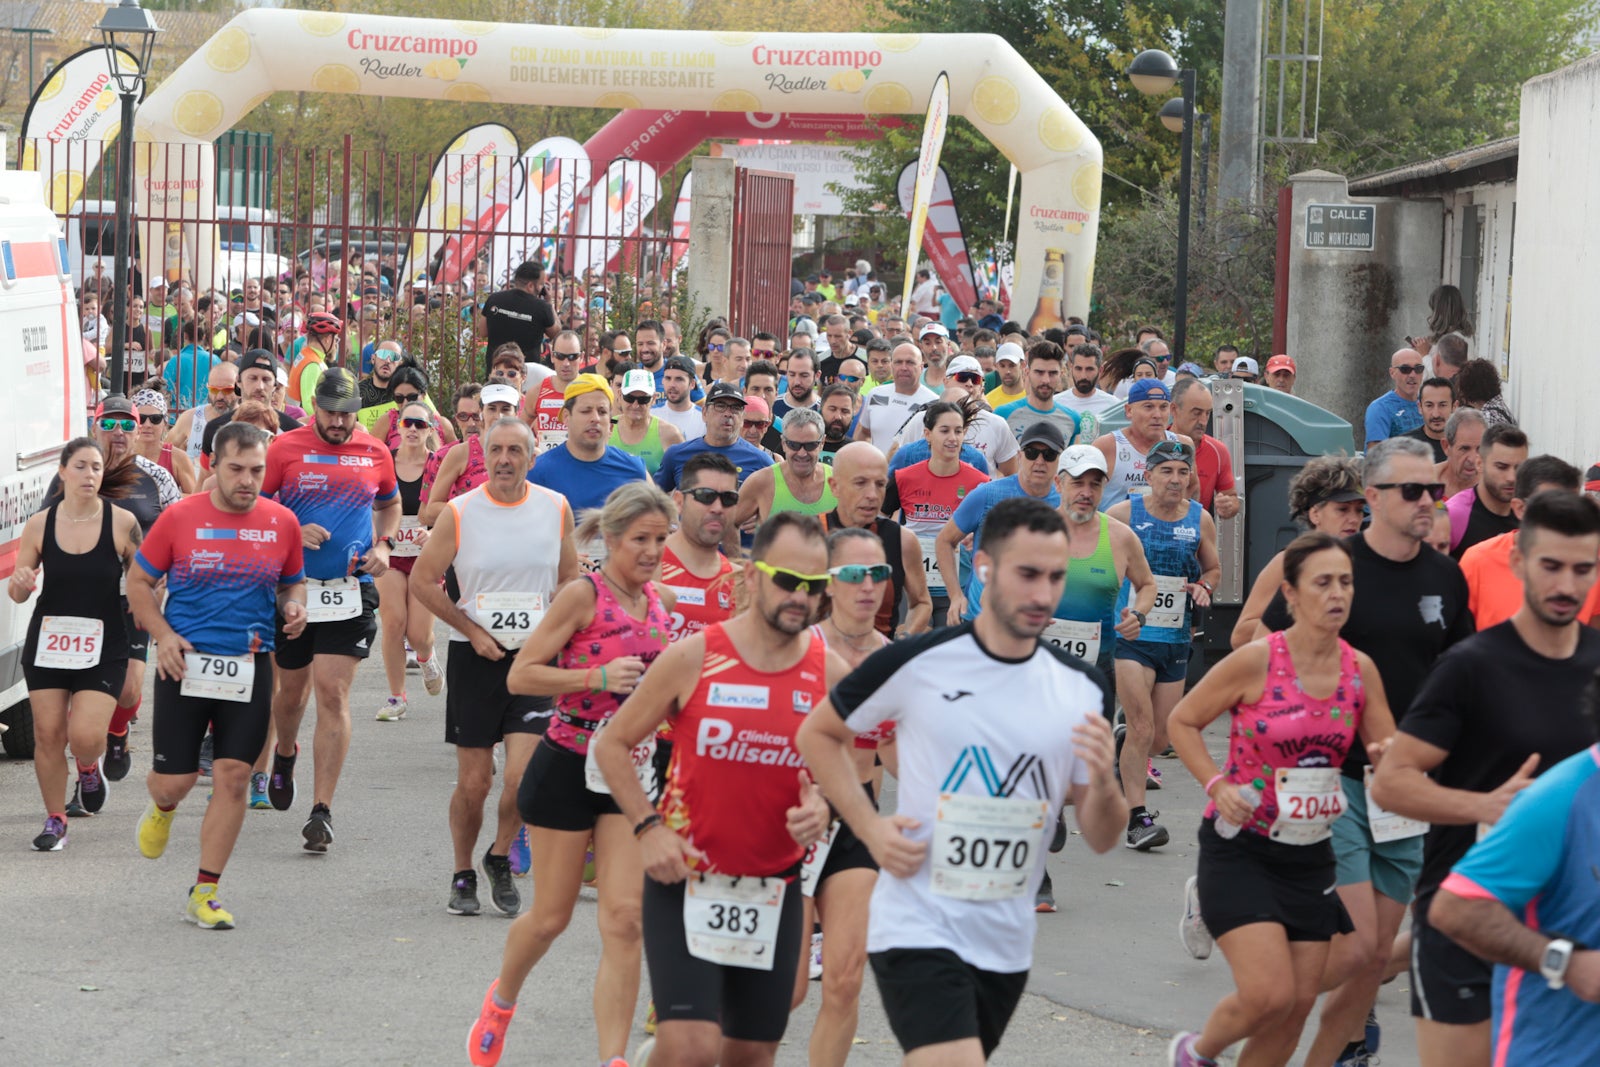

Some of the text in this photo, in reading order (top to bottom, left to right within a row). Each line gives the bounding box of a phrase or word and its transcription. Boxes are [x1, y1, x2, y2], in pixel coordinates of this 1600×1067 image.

[347, 28, 478, 58] Cruzcampo
[510, 46, 716, 68] CON ZUMO NATURAL DE LIMÓN
[752, 44, 882, 69] Cruzcampo
[360, 57, 423, 79] Radler
[510, 65, 716, 89] DOBLEMENTE REFRESCANTE
[765, 73, 827, 93] Radler
[46, 72, 110, 145] Cruzcampo
[1030, 205, 1090, 222] Cruzcampo
[1330, 209, 1367, 220] CALLE
[340, 455, 374, 467] SEUR
[239, 528, 278, 543] SEUR
[320, 590, 344, 606] 65
[491, 611, 531, 630] 243
[46, 633, 96, 653] 2015
[200, 656, 239, 678] 790
[1288, 795, 1341, 820] 2044
[946, 835, 1029, 869] 3070
[707, 903, 759, 935] 383
